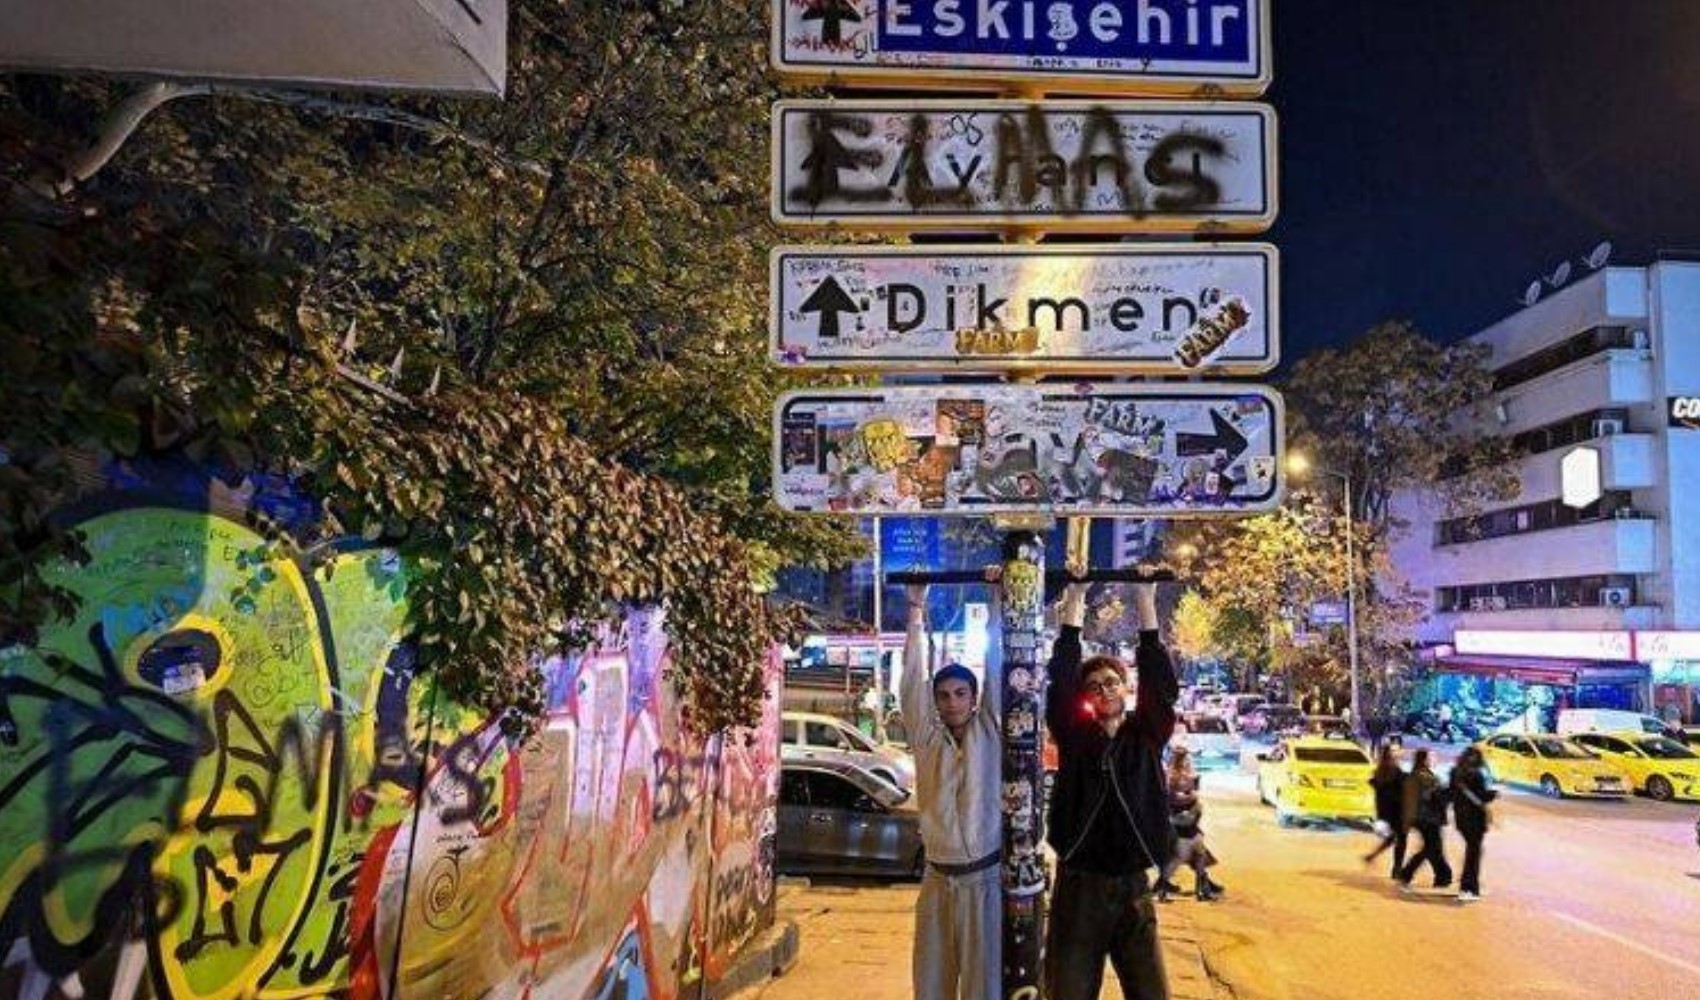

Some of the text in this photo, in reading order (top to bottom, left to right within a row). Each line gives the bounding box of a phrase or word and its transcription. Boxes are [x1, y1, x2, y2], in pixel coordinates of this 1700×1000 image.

[886, 0, 1240, 52] Eskişehir
[887, 282, 1197, 332] Dikmen
[957, 327, 1028, 354] FARM
[1176, 298, 1246, 367] FARM
[1086, 400, 1160, 436] FARM
